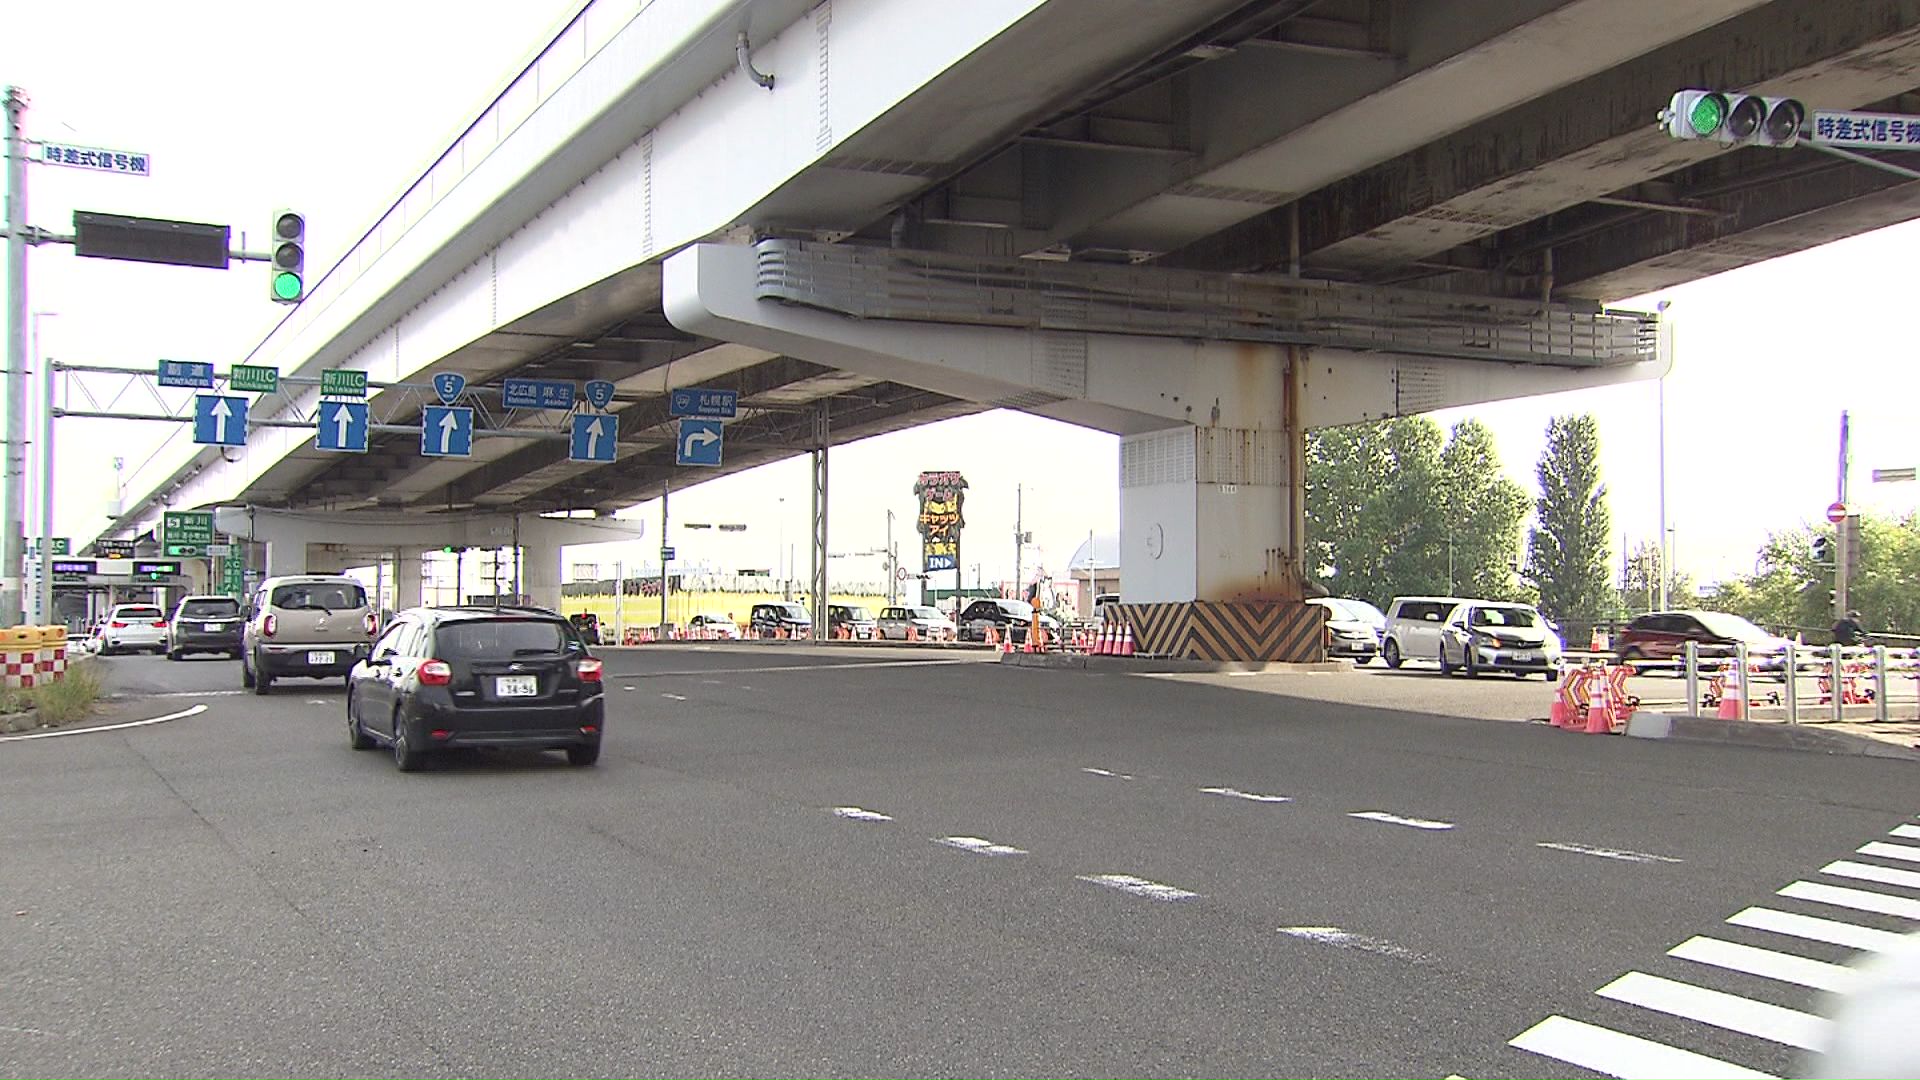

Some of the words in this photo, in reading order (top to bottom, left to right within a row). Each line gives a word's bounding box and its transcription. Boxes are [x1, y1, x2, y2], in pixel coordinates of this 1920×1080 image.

[1817, 117, 1920, 144] 時差式信号機
[46, 146, 146, 172] 時差式信号機
[444, 381, 453, 393] 5
[595, 388, 604, 400] 5
[919, 511, 960, 525] キャッツ
[929, 524, 949, 537] アイ
[929, 556, 944, 569] IN
